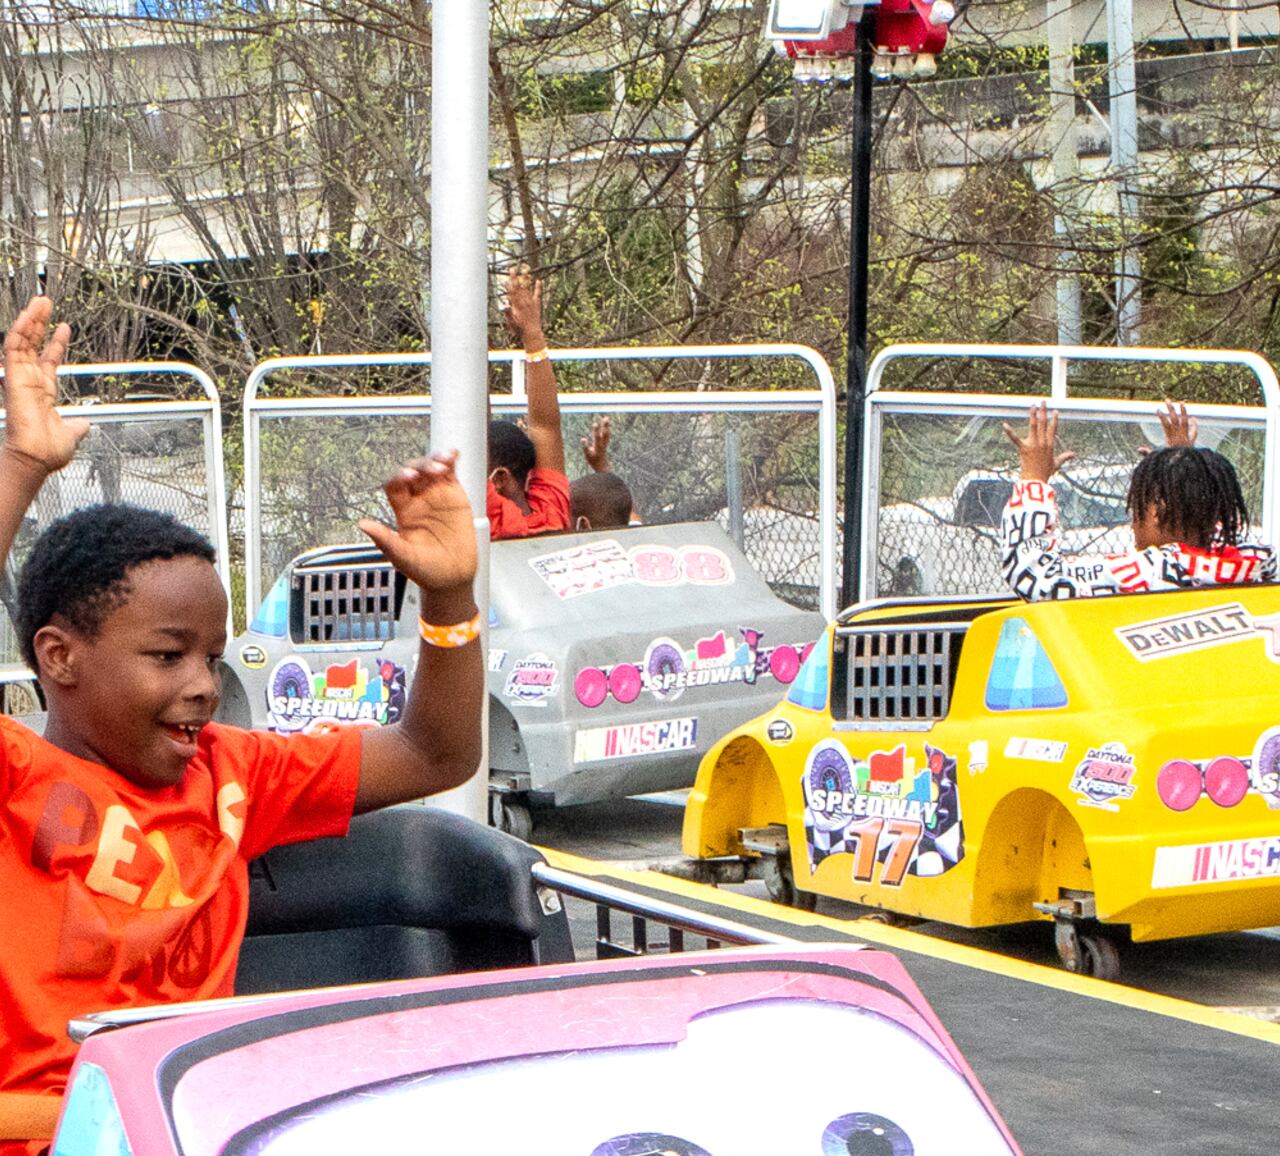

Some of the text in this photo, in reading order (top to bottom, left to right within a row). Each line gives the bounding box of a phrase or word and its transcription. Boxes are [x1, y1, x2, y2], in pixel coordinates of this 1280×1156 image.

[631, 547, 732, 584] 88
[649, 664, 755, 692] SPEEDWAY
[273, 696, 389, 721] SPEEDWAY
[618, 719, 695, 755] NASCAR
[1087, 749, 1133, 765] DAYTONA
[1085, 761, 1135, 785] 500
[811, 789, 938, 823] SPEEDWAY
[847, 815, 923, 887] 17
